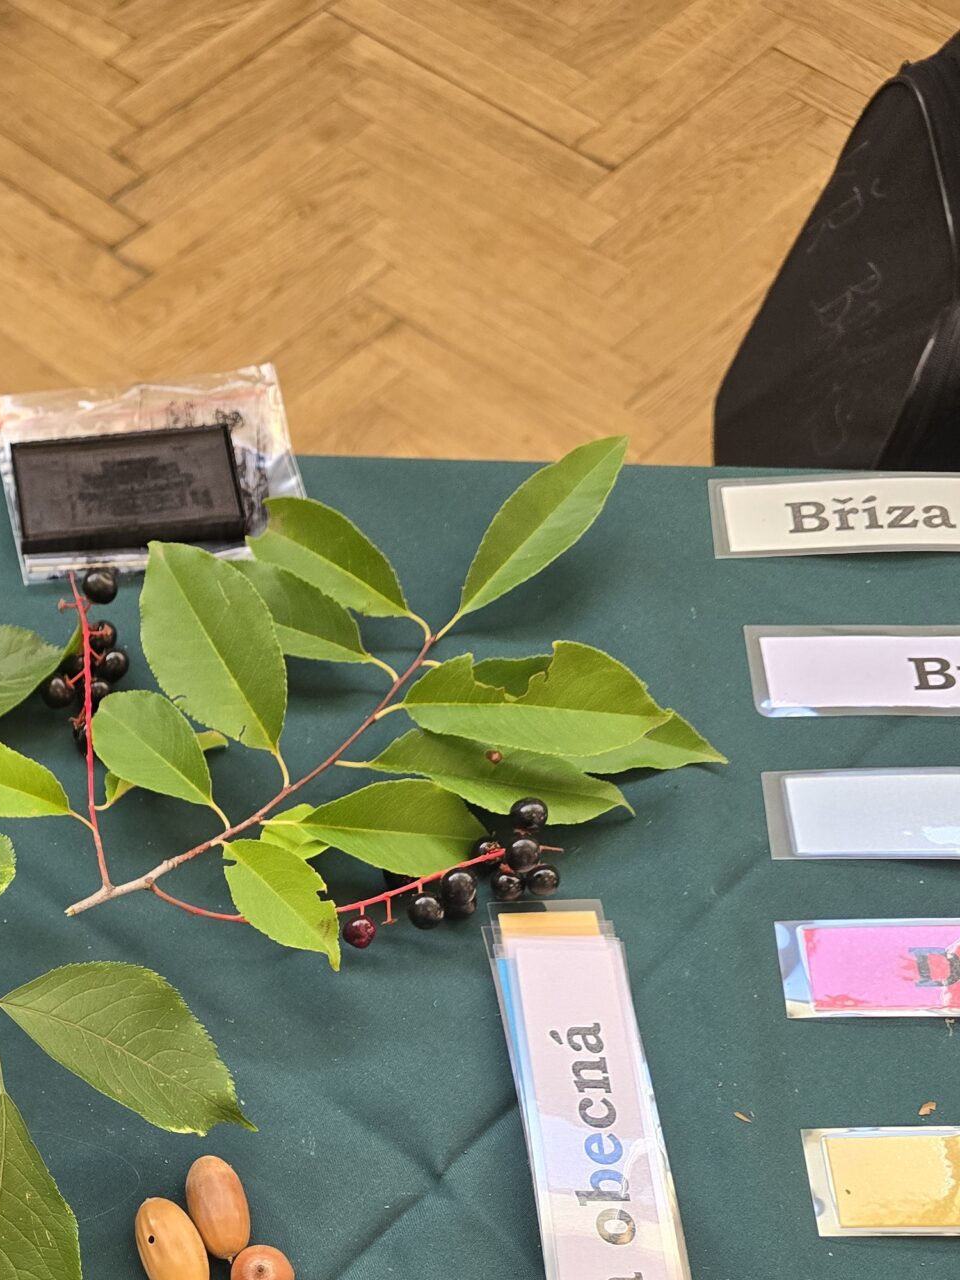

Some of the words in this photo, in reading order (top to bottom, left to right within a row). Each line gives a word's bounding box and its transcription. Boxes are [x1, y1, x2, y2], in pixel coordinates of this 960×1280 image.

[785, 495, 957, 533] Bříza
[907, 657, 960, 690] B
[549, 1022, 637, 1246] obecná
